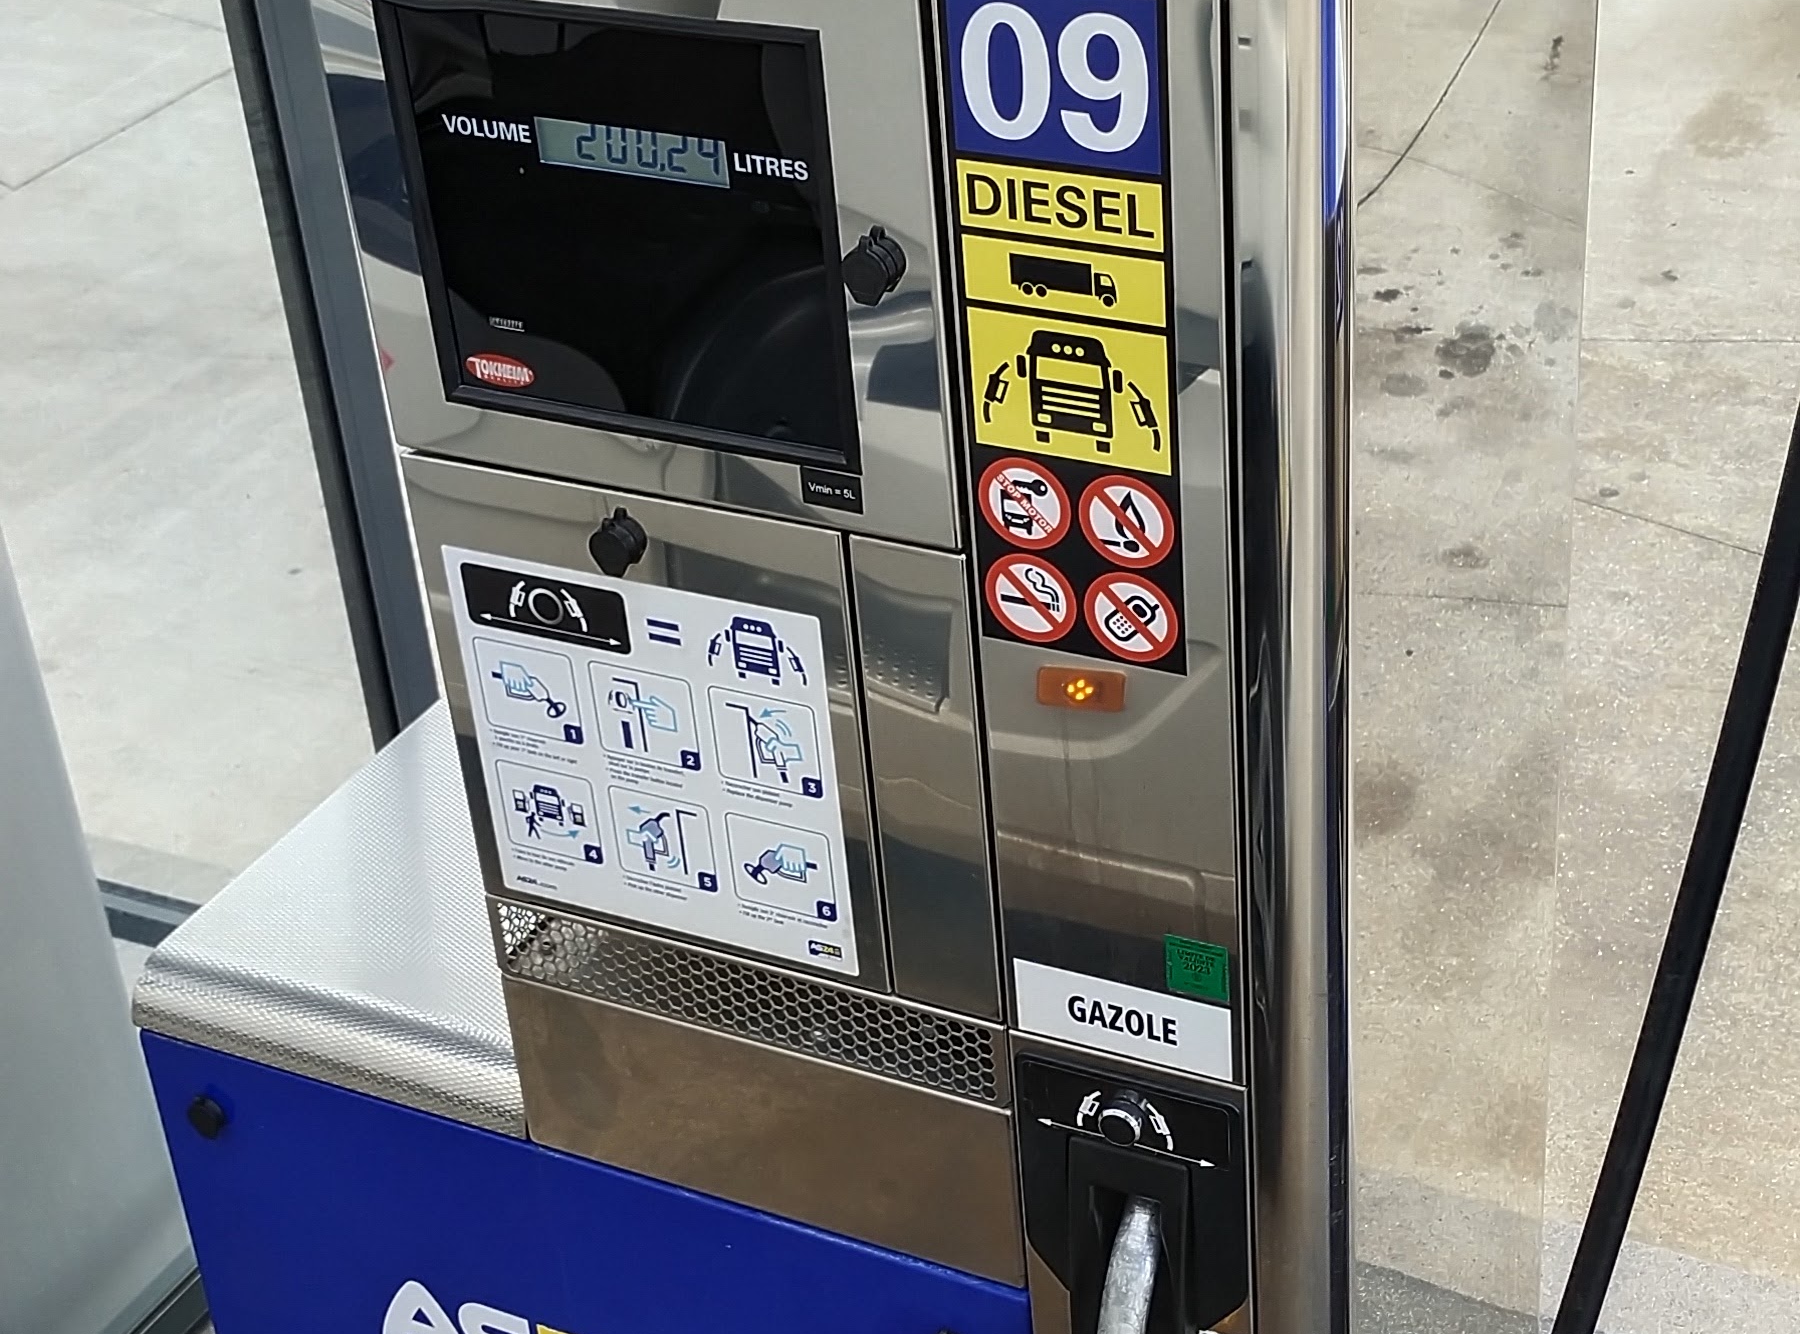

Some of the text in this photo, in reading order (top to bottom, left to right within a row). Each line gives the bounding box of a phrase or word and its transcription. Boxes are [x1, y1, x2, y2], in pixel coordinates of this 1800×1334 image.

[961, 1, 1149, 152] 09
[442, 114, 532, 144] VOLUME
[734, 152, 809, 181] LITRES
[965, 173, 1156, 239] DIESEL
[467, 356, 530, 382] TOKHEIM
[808, 482, 833, 495] Vmin
[843, 489, 856, 500] 5L
[997, 473, 1053, 534] STOP MOTOR
[570, 729, 576, 739] 1
[686, 755, 695, 766] 2
[808, 782, 816, 793] 3
[589, 849, 598, 859] 4
[704, 877, 712, 887] 5
[822, 906, 831, 916] 6
[1067, 995, 1178, 1047] GAZOLE
